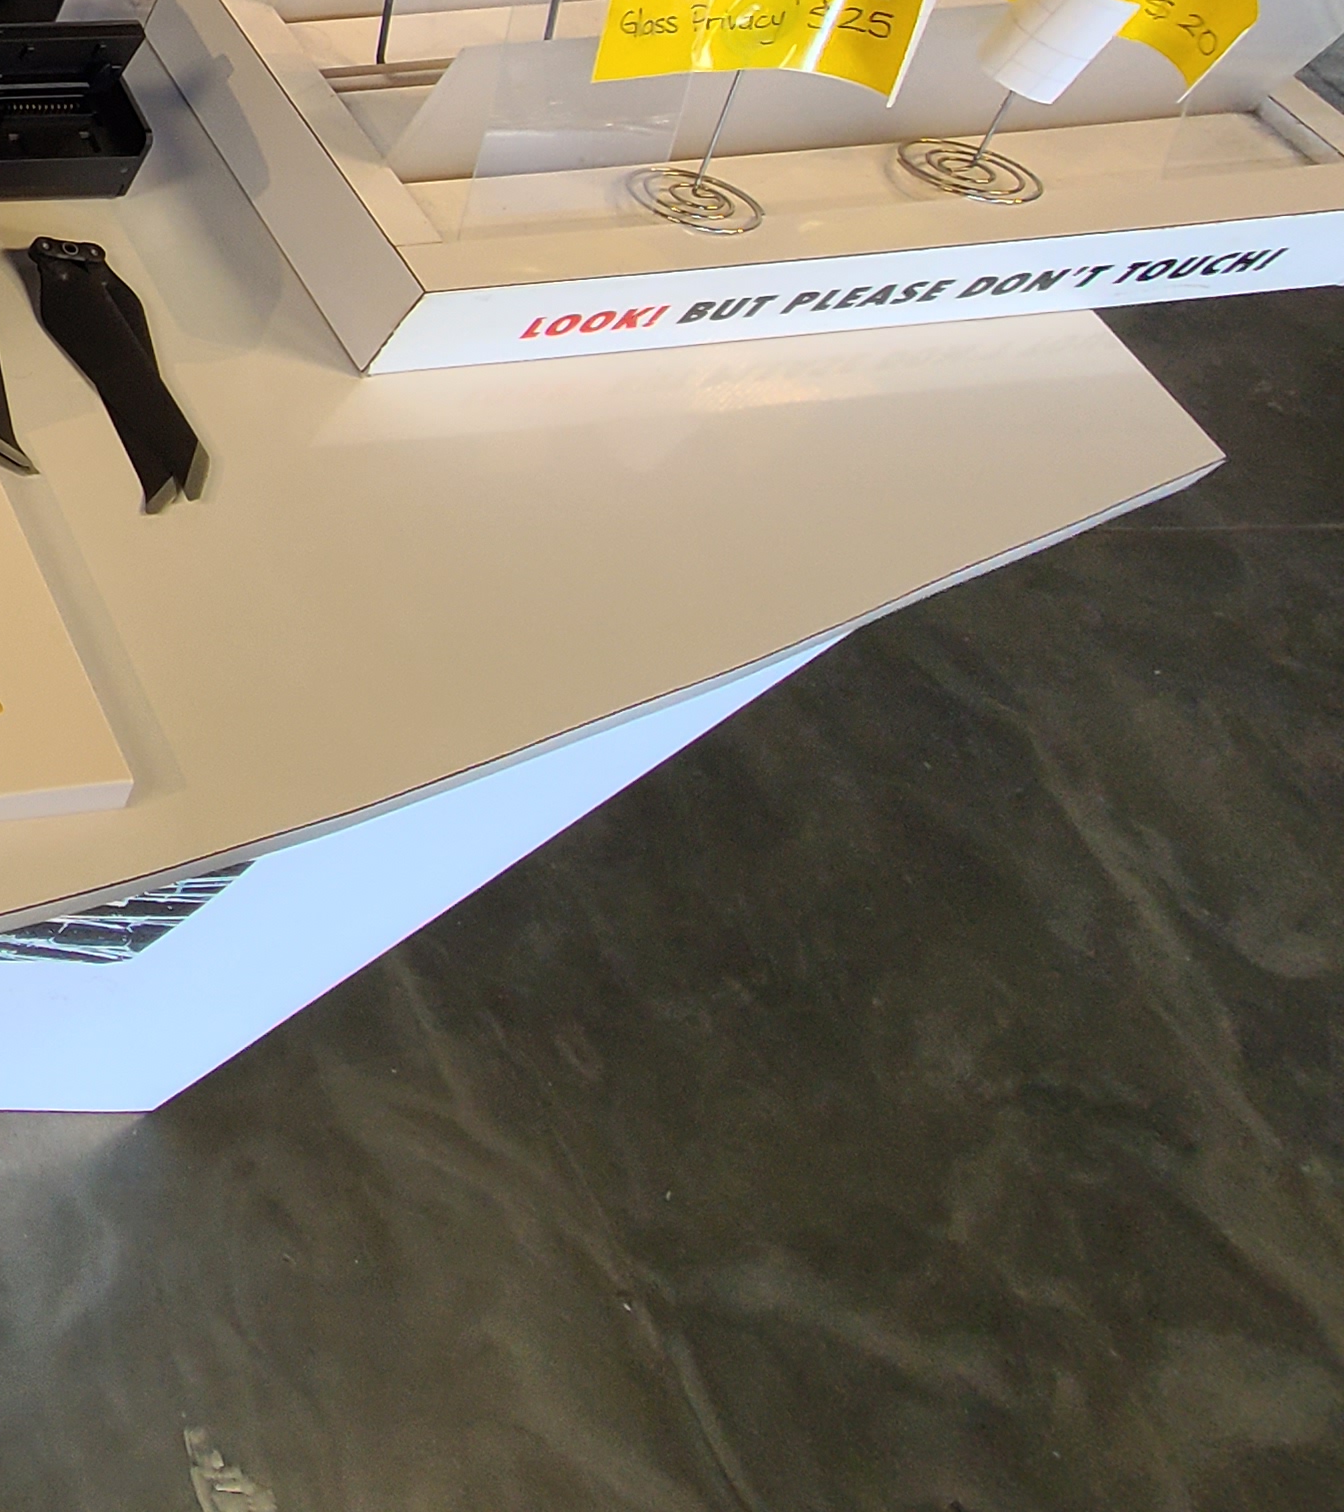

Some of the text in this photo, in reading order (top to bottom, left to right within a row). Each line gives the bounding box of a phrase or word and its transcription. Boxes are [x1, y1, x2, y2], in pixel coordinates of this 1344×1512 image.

[620, 0, 895, 45] Glass Privacy $25
[519, 247, 1290, 339] LOOK! BUT PLEASE DON'T TOUCH!
